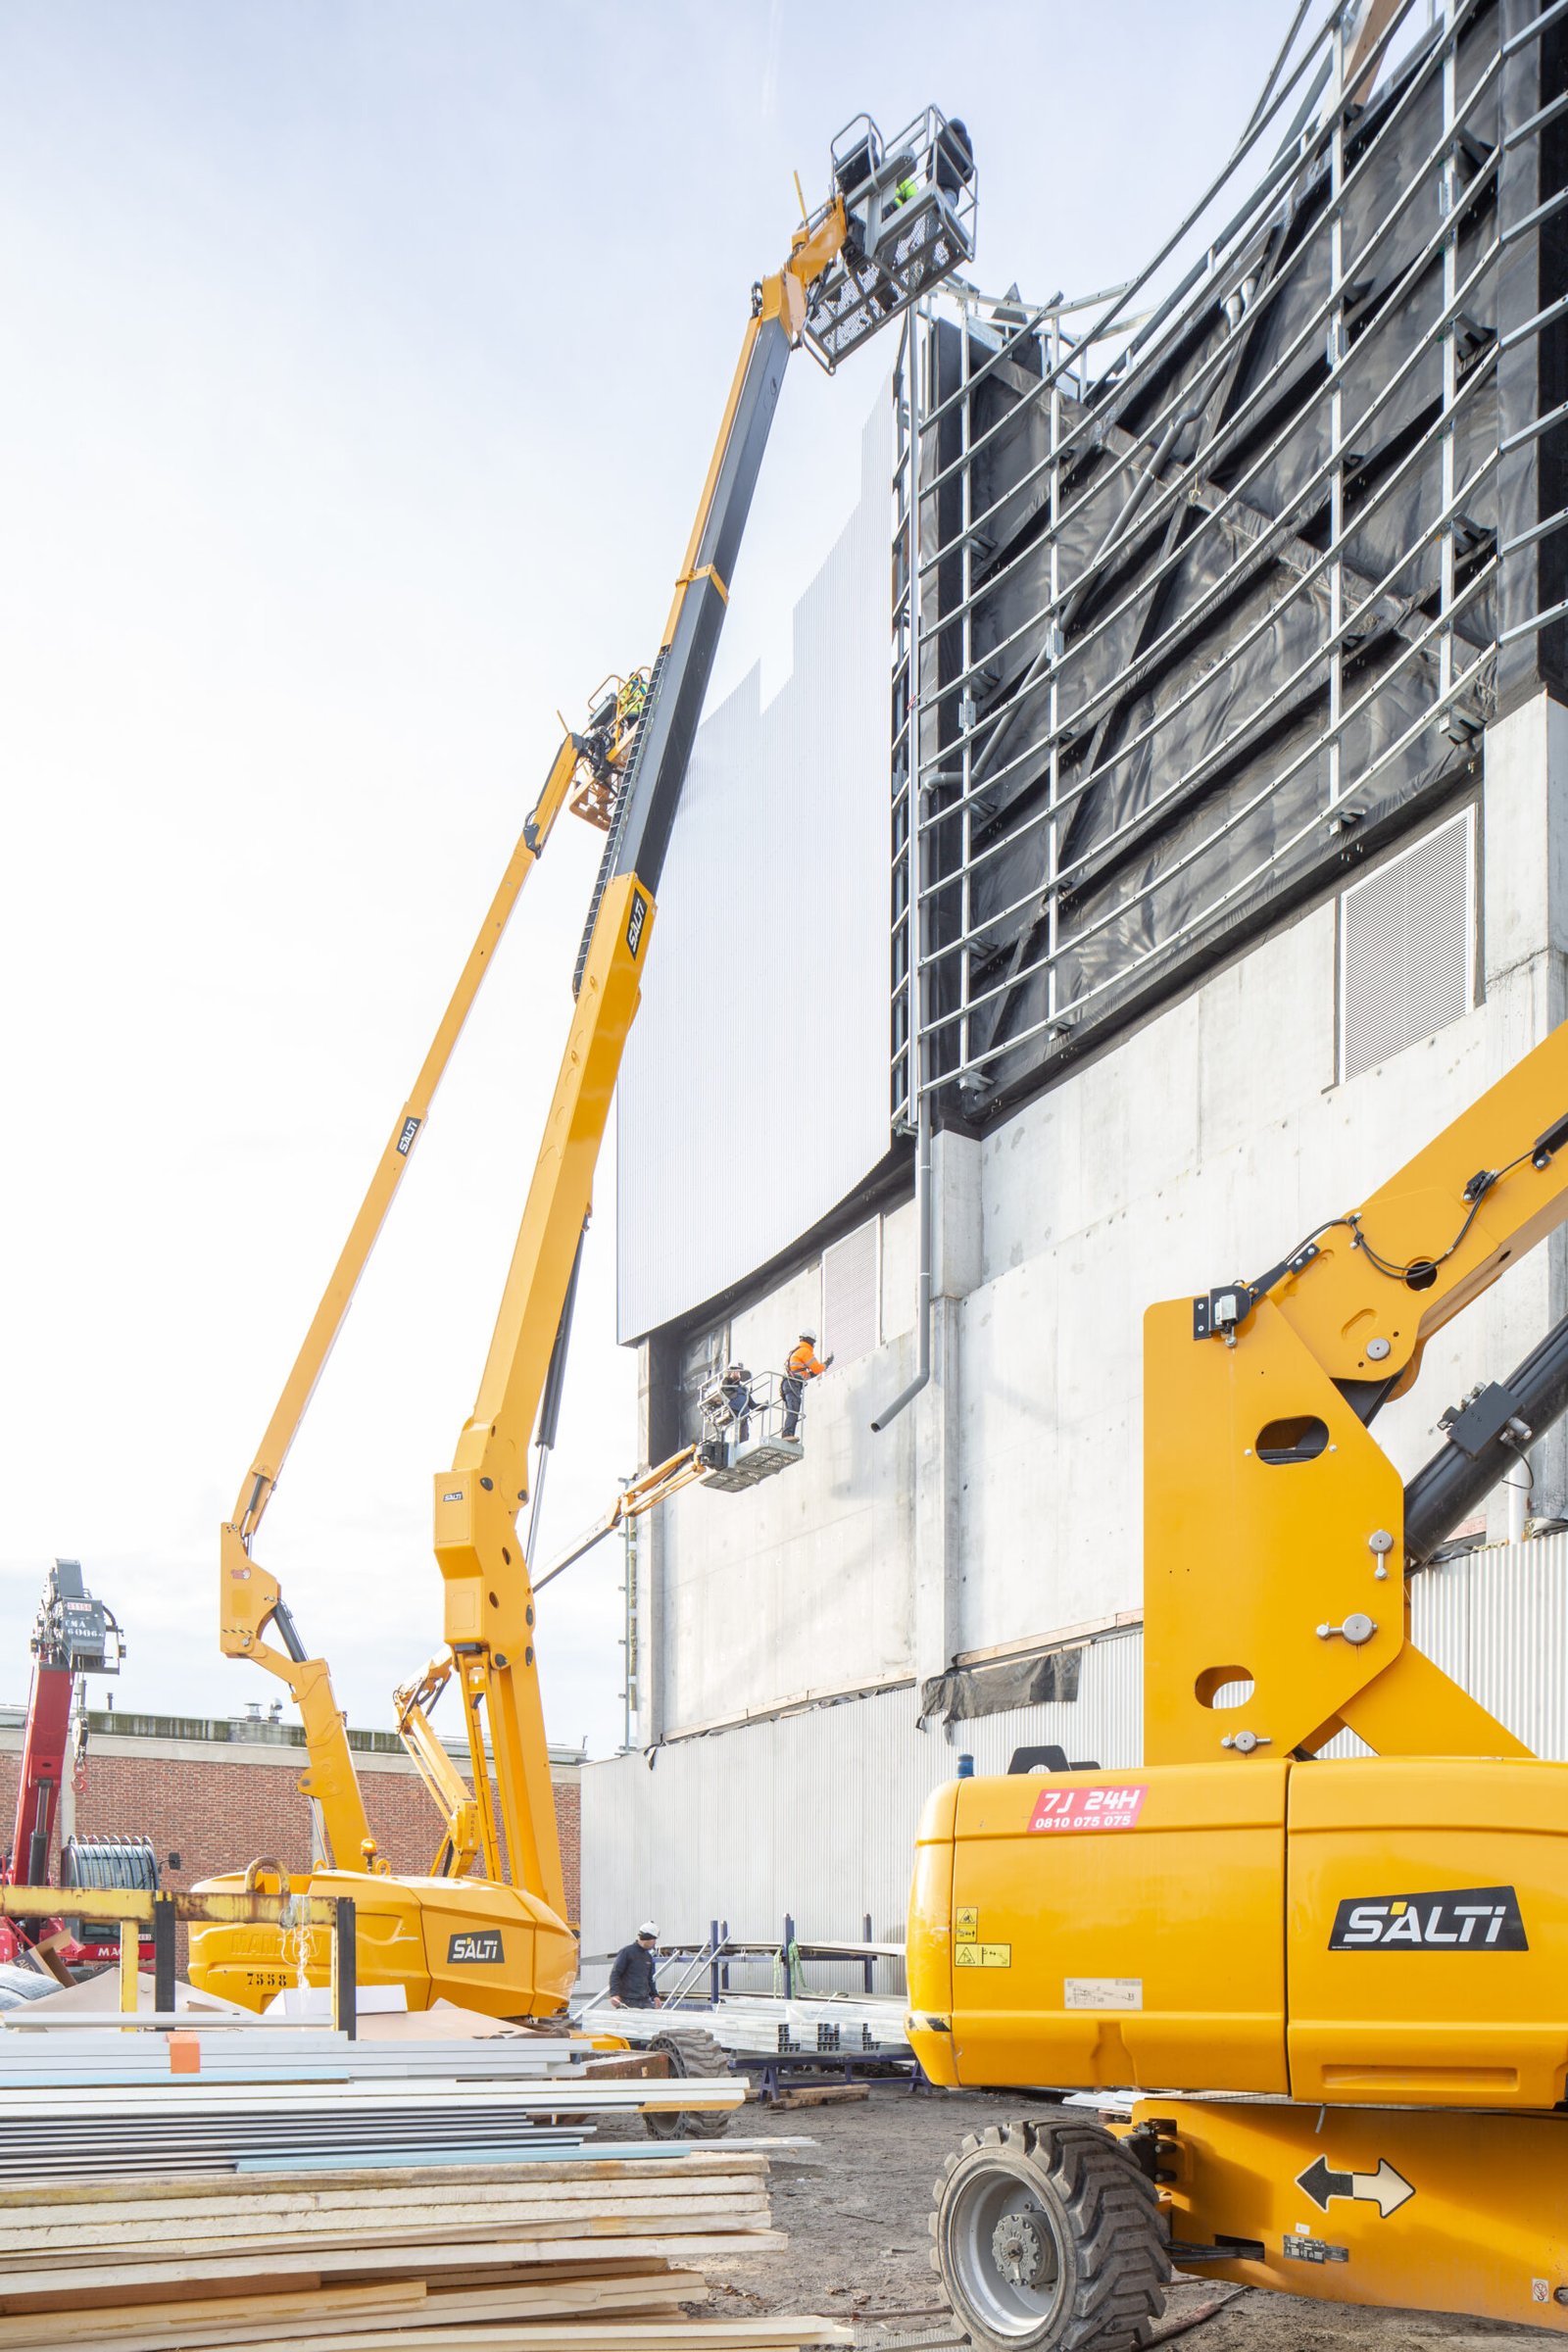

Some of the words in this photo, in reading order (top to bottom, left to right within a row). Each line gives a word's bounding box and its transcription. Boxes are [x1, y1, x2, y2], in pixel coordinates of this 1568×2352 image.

[1043, 1792, 1075, 1814] 7J
[1084, 1789, 1141, 1810] 24H
[1035, 1817, 1070, 1829] 0810
[1073, 1816, 1101, 1828] 075
[1103, 1815, 1131, 1827] 075
[247, 1973, 287, 1986] 7558
